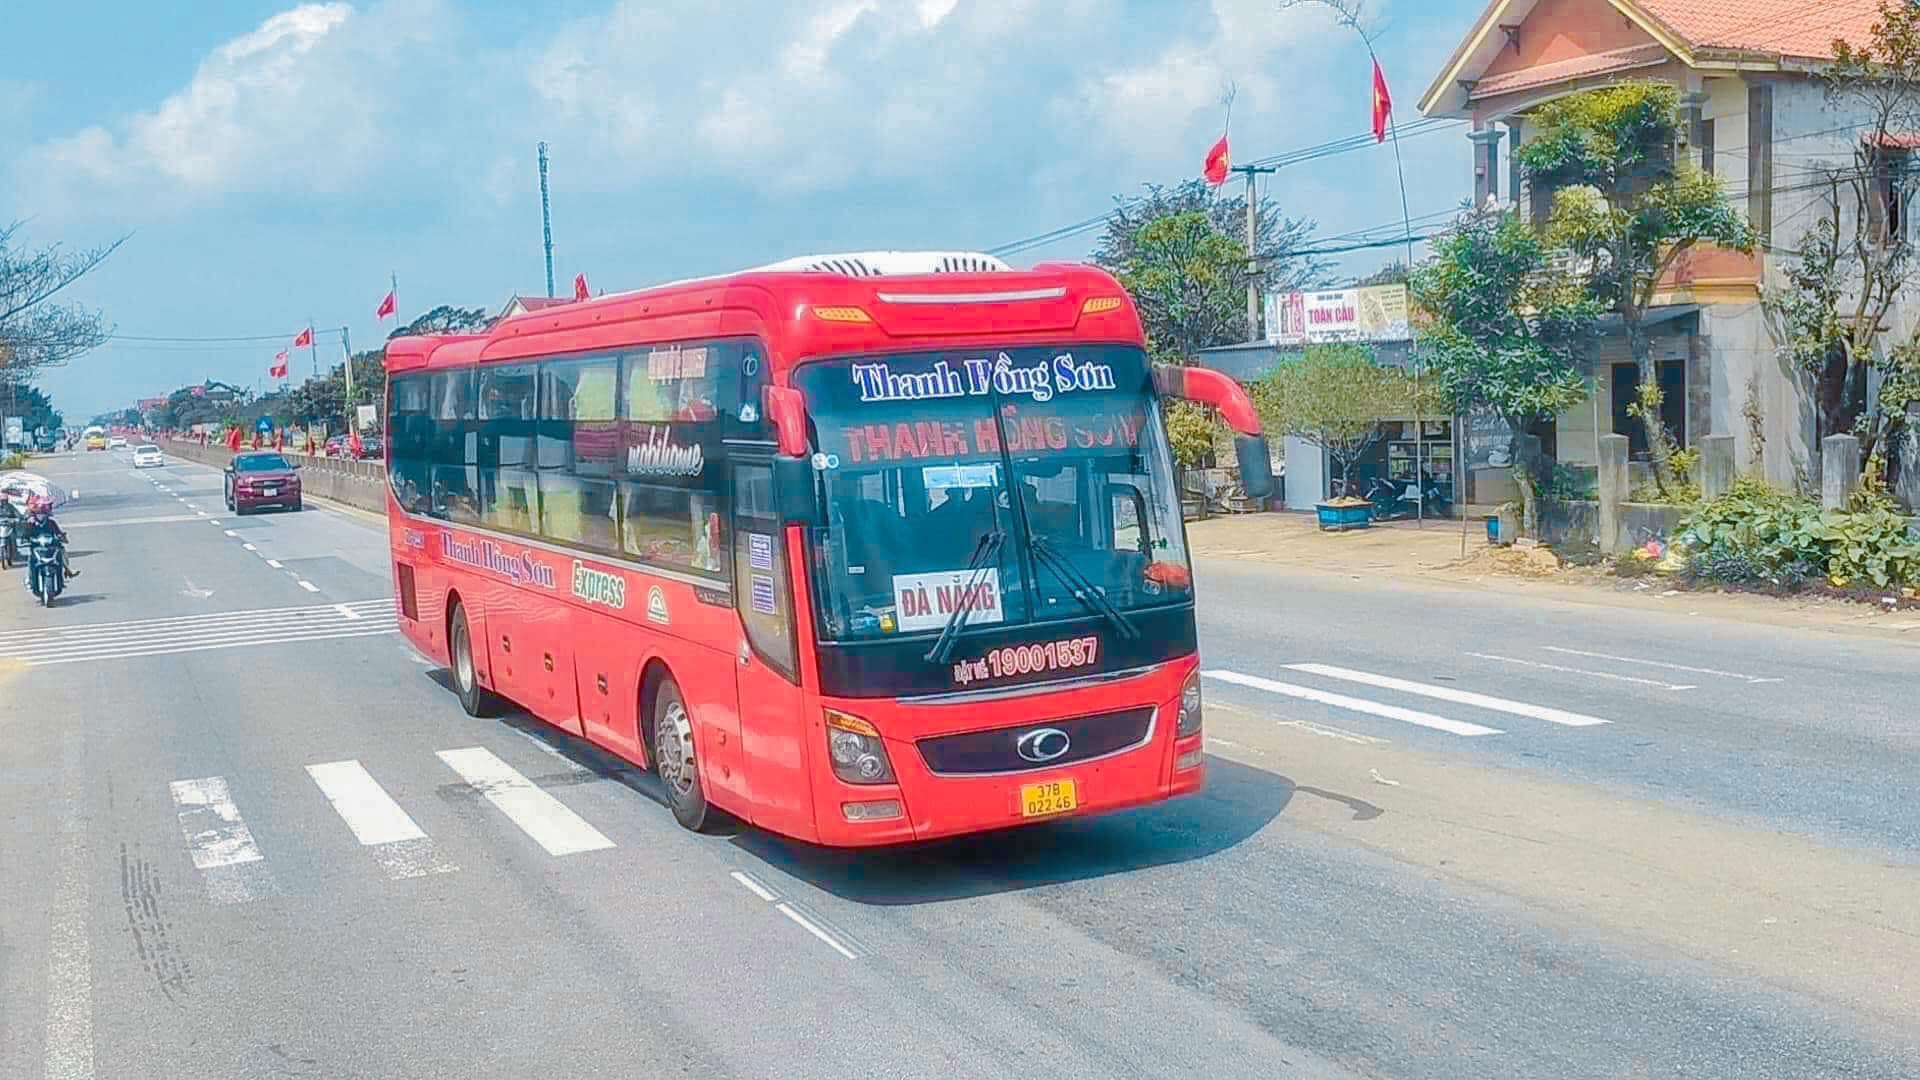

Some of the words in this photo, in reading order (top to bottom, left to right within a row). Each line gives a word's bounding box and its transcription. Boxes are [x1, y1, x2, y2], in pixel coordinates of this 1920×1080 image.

[853, 361, 964, 401] Thanh
[964, 352, 1053, 401] Hồng
[1053, 353, 1116, 392] Sơn
[844, 421, 968, 462] THANH
[441, 530, 481, 567] Thanh
[521, 550, 556, 588] Sơn
[573, 559, 625, 608] Express
[901, 582, 932, 617] ĐÀ
[988, 636, 1098, 677] 19001537
[1037, 783, 1060, 798] 37B
